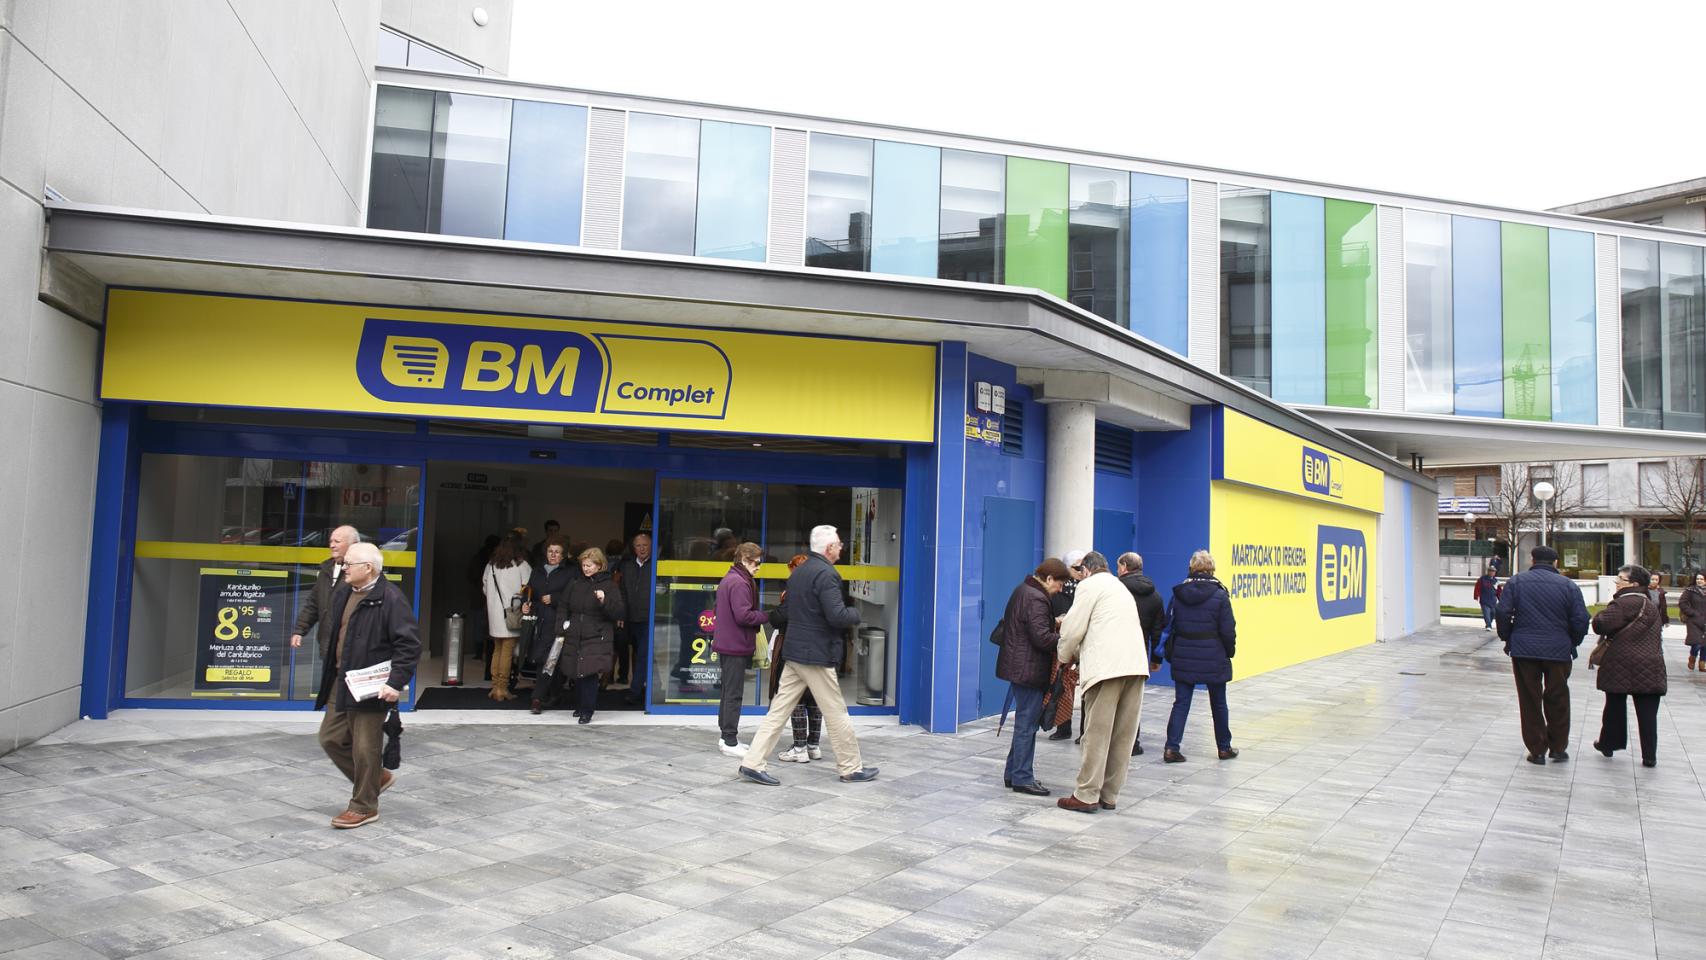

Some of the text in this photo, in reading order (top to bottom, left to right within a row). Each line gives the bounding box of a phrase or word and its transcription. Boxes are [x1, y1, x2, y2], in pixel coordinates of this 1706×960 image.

[461, 340, 581, 397] BM
[616, 381, 715, 406] Complet
[1314, 458, 1328, 488] BM
[1589, 522, 1622, 530] LAGUNA
[1232, 543, 1273, 567] MARTXOAK
[1274, 545, 1282, 567] 10
[1231, 571, 1307, 599] APERTURA 10 MARZO
[1339, 544, 1364, 601] BM
